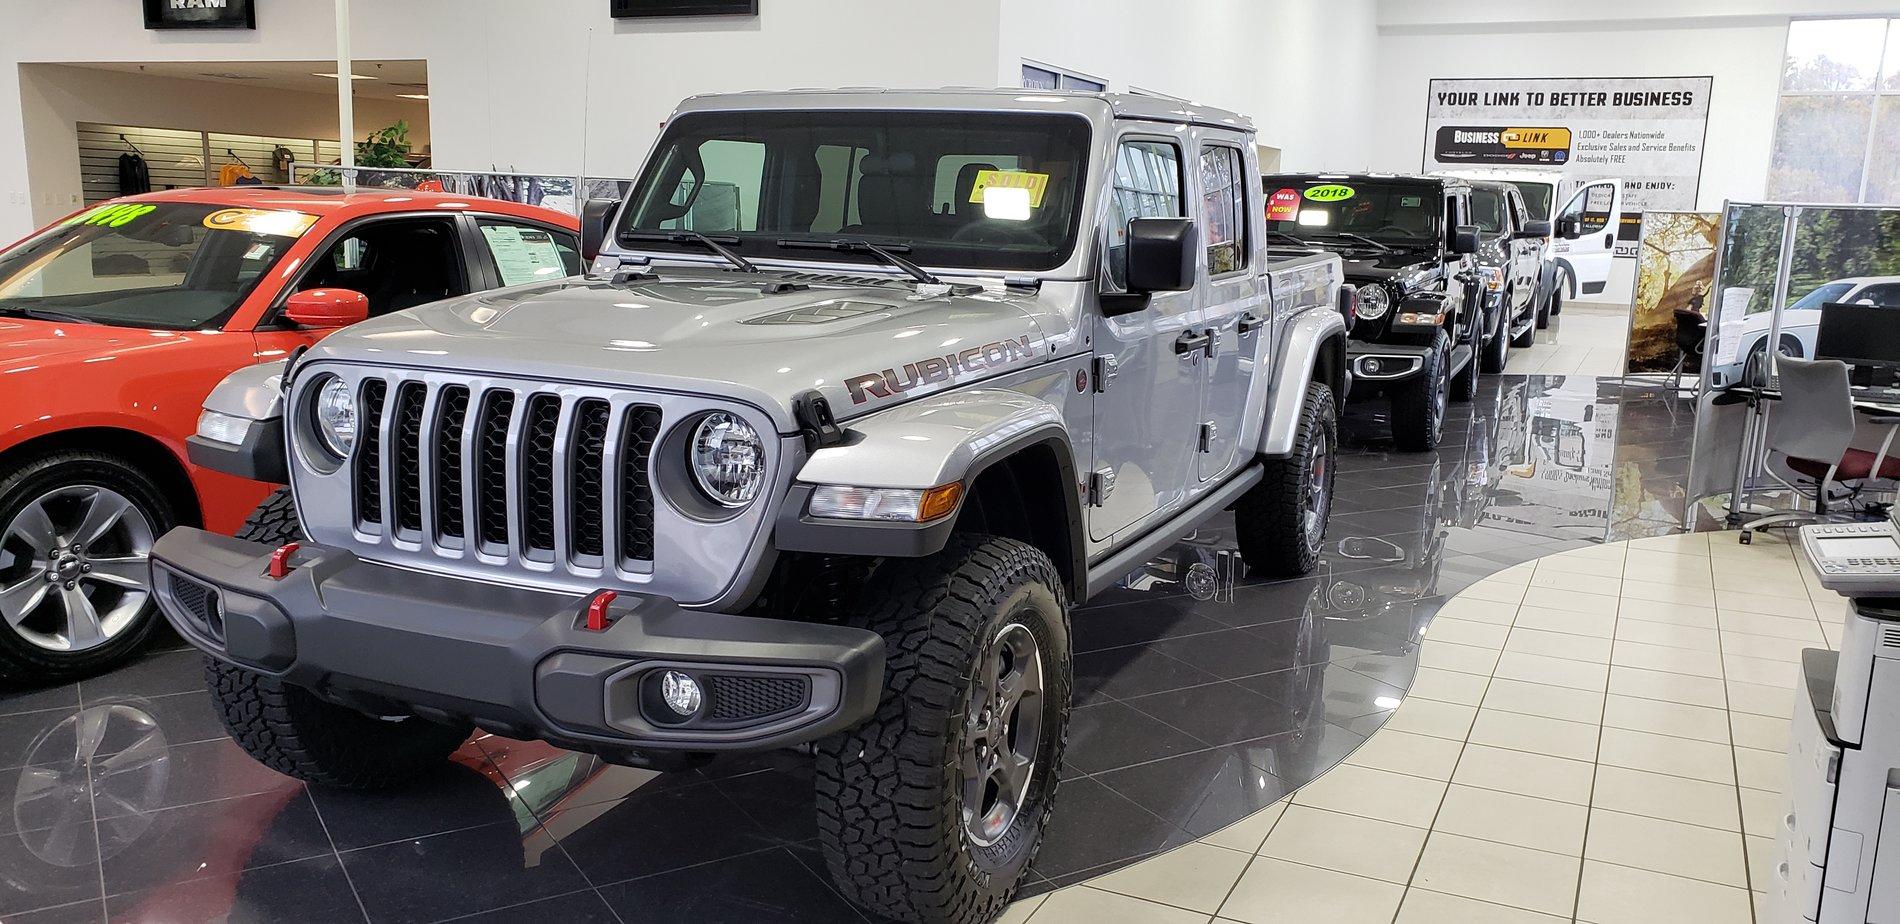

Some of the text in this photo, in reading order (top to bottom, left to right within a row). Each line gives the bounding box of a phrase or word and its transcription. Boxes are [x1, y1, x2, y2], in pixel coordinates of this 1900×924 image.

[170, 0, 227, 9] RAM
[1437, 91, 1694, 107] YOUR LINK TO BETTER BUSINESS
[1453, 130, 1549, 144] BUSINESS LINK
[1602, 130, 1628, 139] Dealers
[1629, 130, 1665, 139] Nationwide
[1577, 142, 1696, 152] Exclusive Sales and Service Benefits
[1519, 152, 1537, 160] Jeep
[1576, 154, 1626, 165] Absolutely FREE
[1624, 181, 1642, 190] AND
[1645, 181, 1676, 190] ENJOY:
[1311, 188, 1349, 197] 2018
[1272, 205, 1293, 213] NOW
[843, 334, 1034, 405] RUBICON
